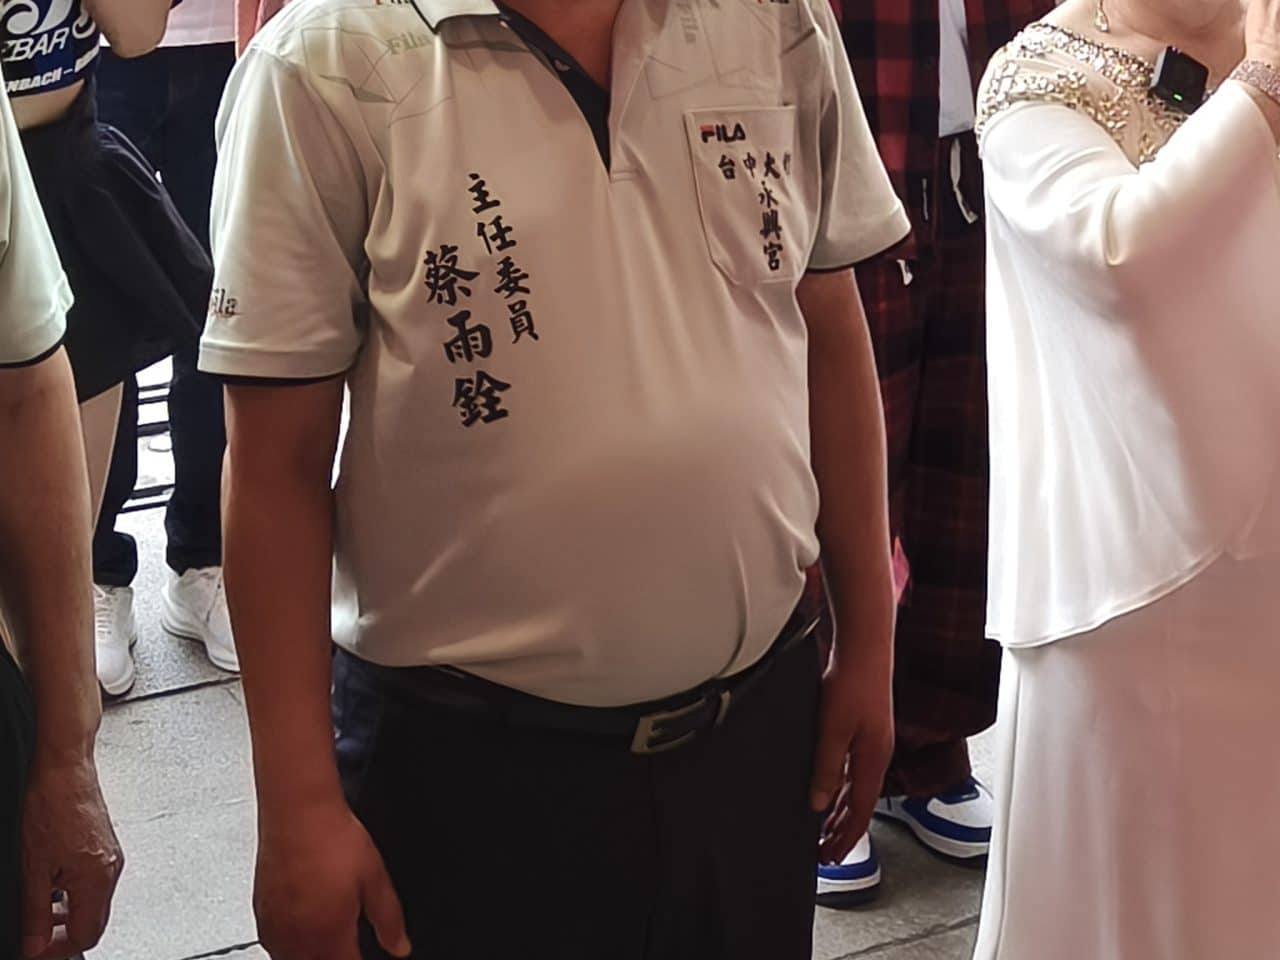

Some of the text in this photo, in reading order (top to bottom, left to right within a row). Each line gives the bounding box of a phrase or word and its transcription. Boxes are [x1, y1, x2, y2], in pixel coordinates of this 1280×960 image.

[701, 122, 747, 144] FILA
[467, 172, 540, 345] 主任委員
[758, 180, 784, 271] 永興宮
[211, 288, 240, 319] ila
[423, 244, 513, 428] 蔡雨銓
